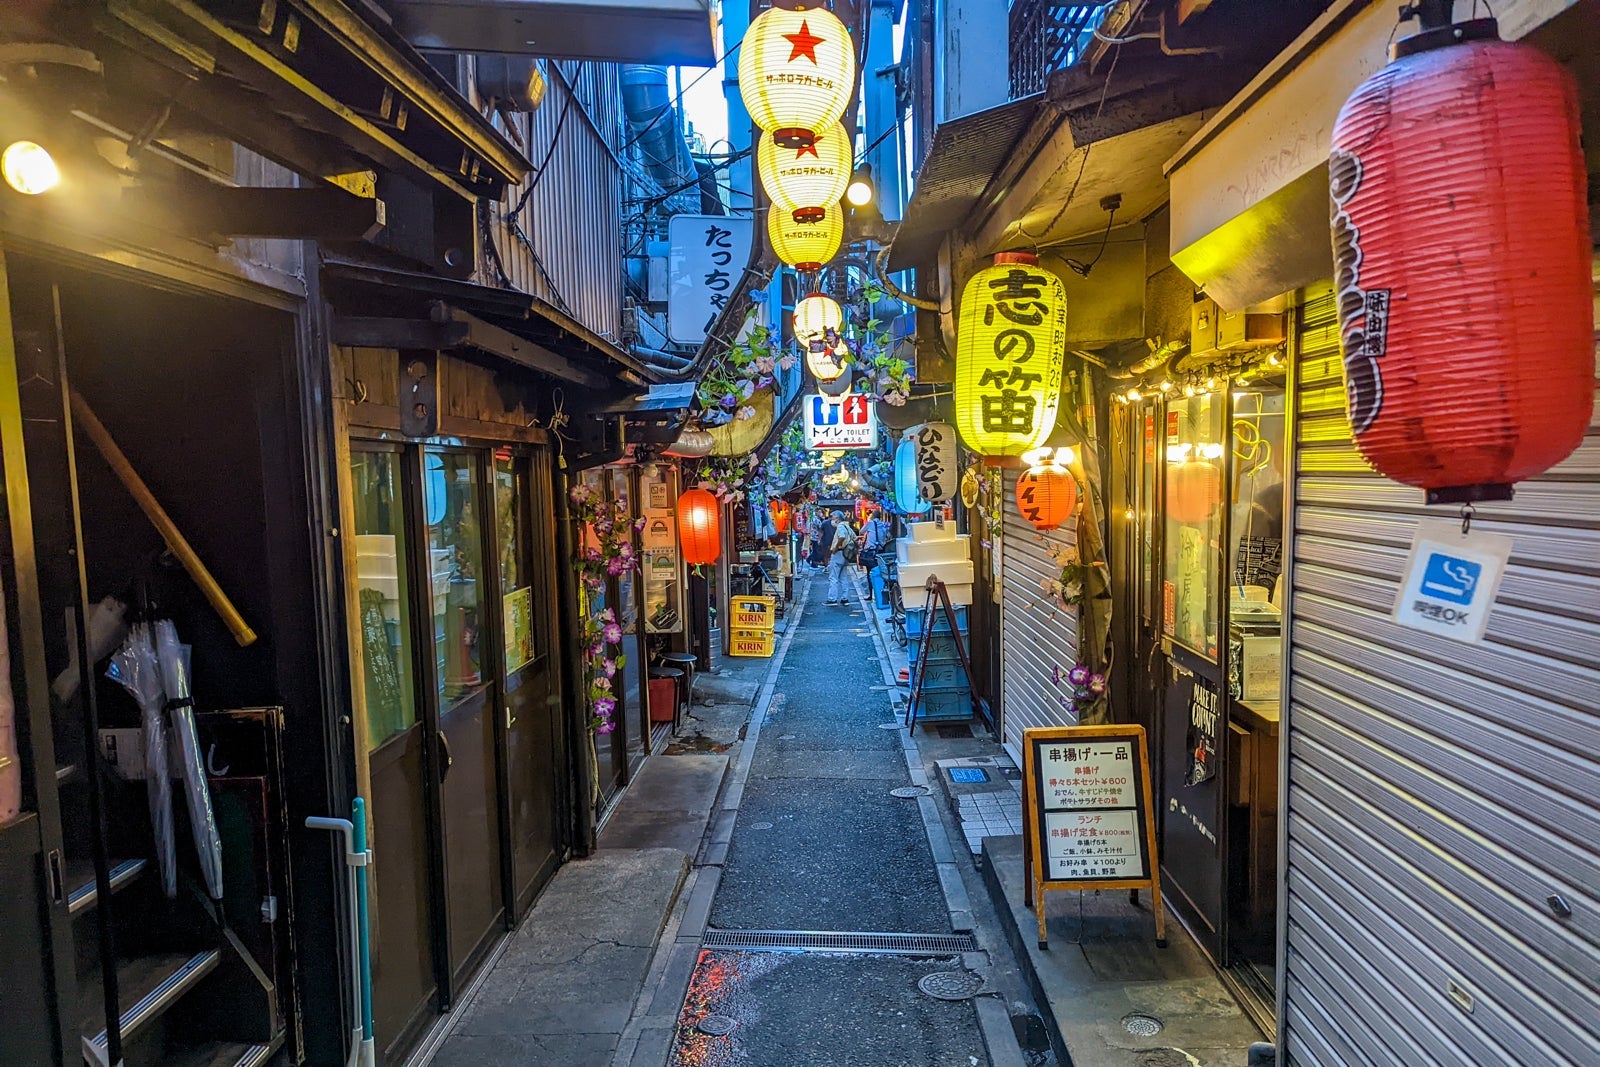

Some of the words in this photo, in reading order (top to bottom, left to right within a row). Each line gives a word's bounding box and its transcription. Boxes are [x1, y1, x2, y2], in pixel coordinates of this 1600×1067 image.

[978, 269, 1050, 436] 志の笛
[813, 427, 843, 438] トイレ
[846, 428, 871, 436] TOILET
[917, 427, 945, 499] ひなどり
[738, 614, 764, 623] KIRIN
[737, 642, 764, 651] KIRIN
[1193, 682, 1210, 710] MAKE
[1191, 702, 1217, 738] COUNT
[1074, 766, 1100, 776] 串揚げ
[1077, 815, 1103, 825] ランチ
